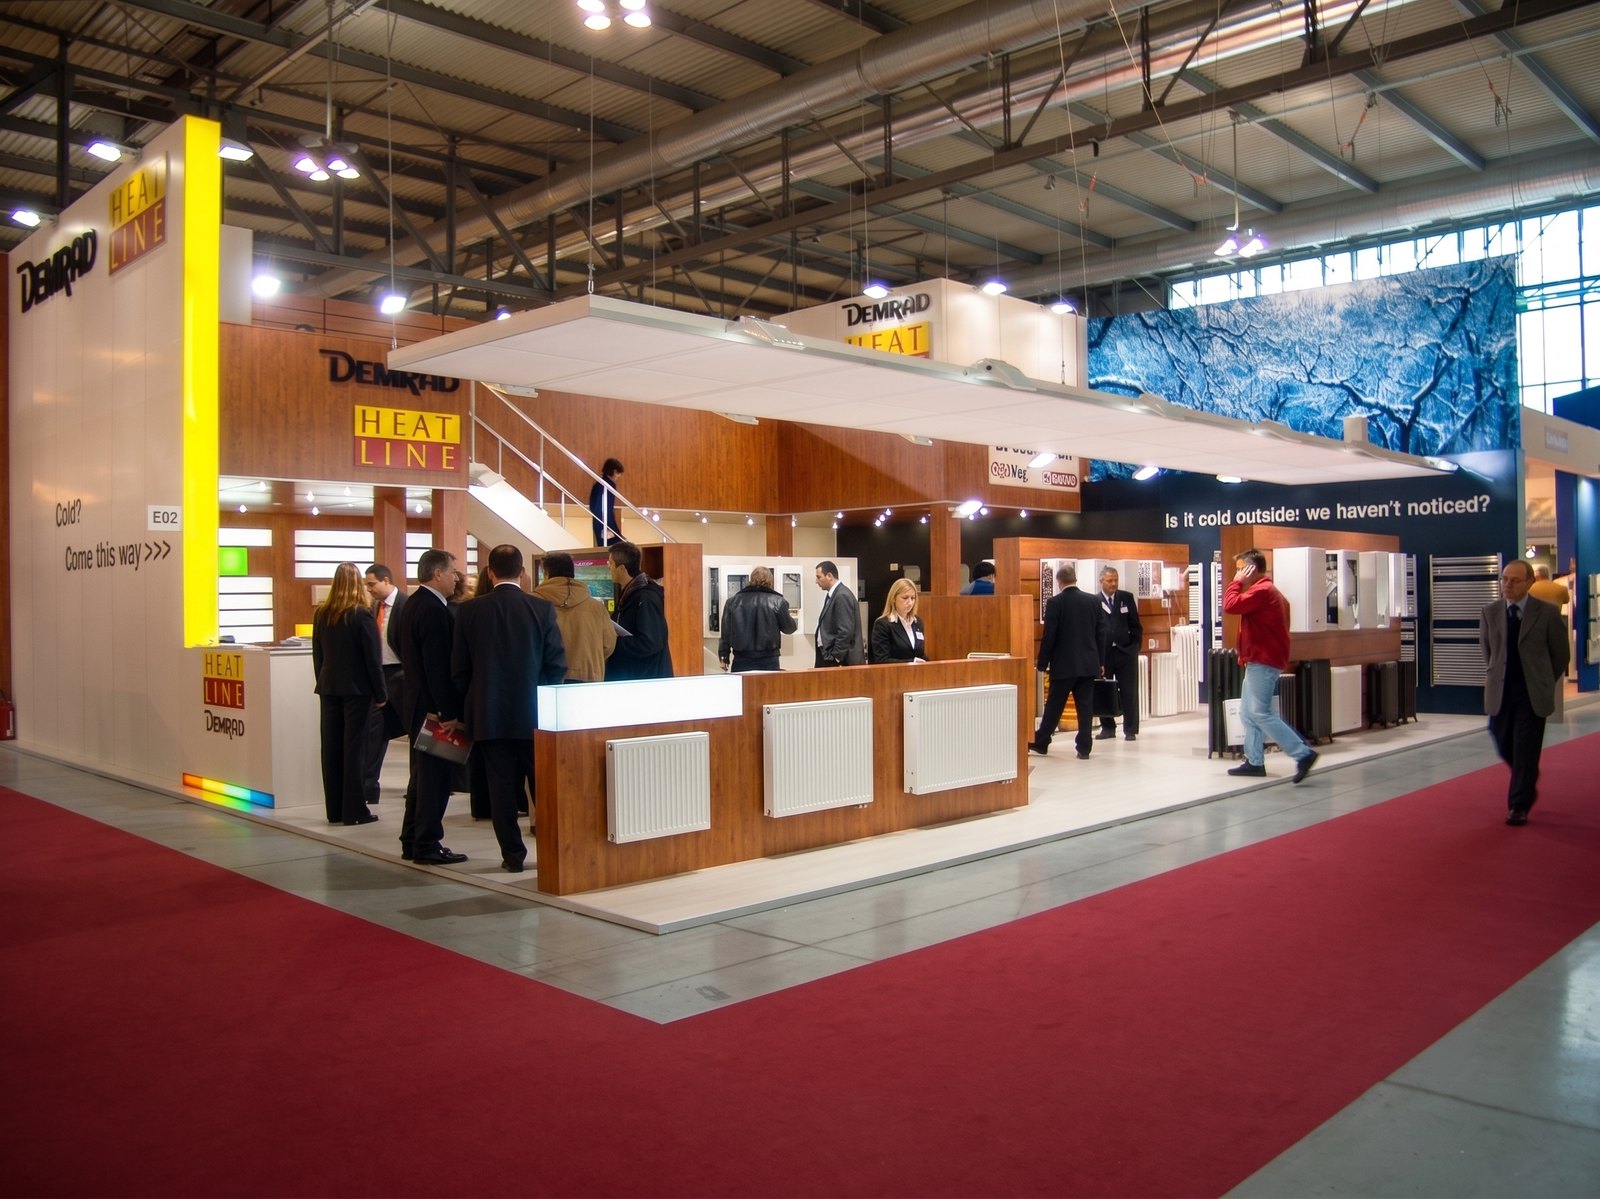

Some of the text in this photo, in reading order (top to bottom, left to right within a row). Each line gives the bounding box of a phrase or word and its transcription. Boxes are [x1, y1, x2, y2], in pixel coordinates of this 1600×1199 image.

[111, 203, 162, 269] LINE
[17, 228, 97, 313] DEMRAD
[842, 293, 930, 327] DEMRAD
[361, 409, 452, 440] HEAT
[361, 440, 455, 470] LINE
[55, 498, 82, 528] Cold?
[152, 511, 178, 524] E02
[1165, 494, 1491, 528] Is it cold outside! we haven't noticed?
[65, 541, 142, 571] Come this way
[205, 653, 241, 677] HEAT
[205, 680, 243, 706] LINE
[204, 709, 245, 740] DEMRAD
